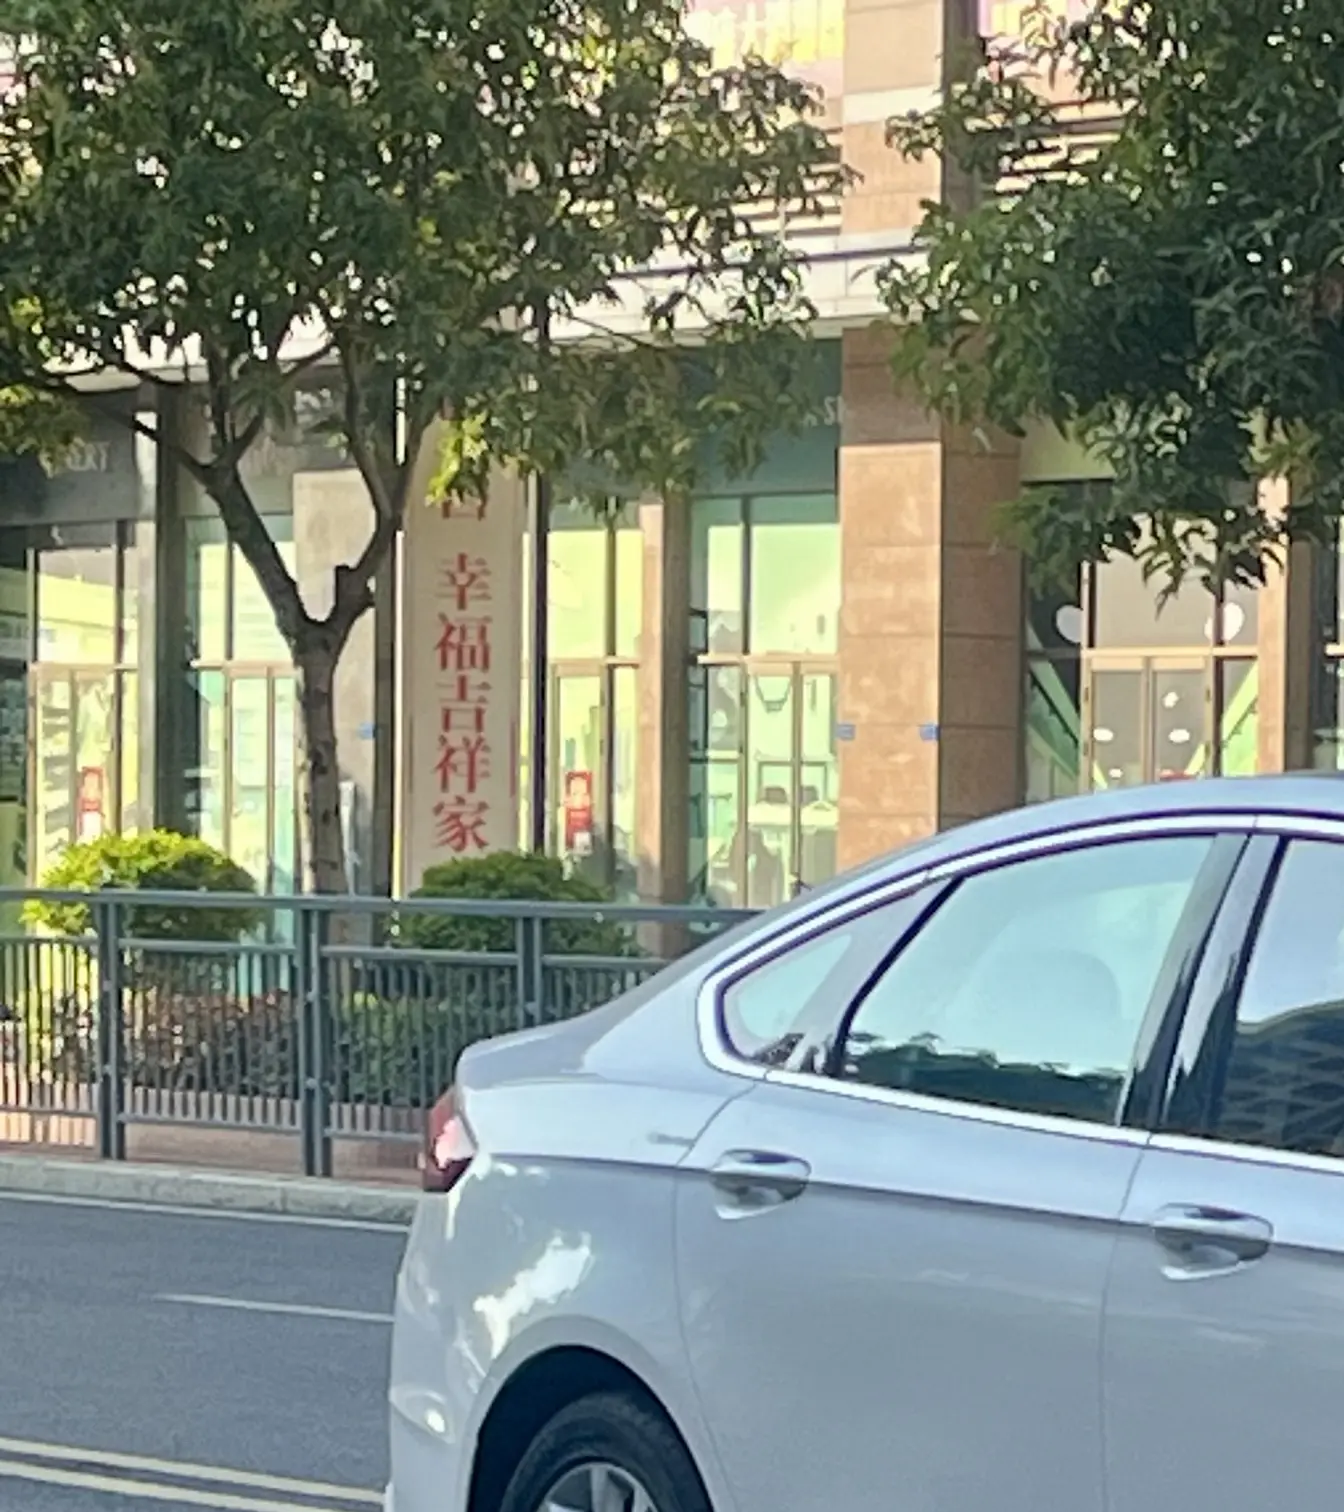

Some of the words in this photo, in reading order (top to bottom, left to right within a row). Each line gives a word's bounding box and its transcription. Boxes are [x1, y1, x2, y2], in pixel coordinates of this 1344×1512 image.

[433, 551, 493, 853] 幸福吉祥家
